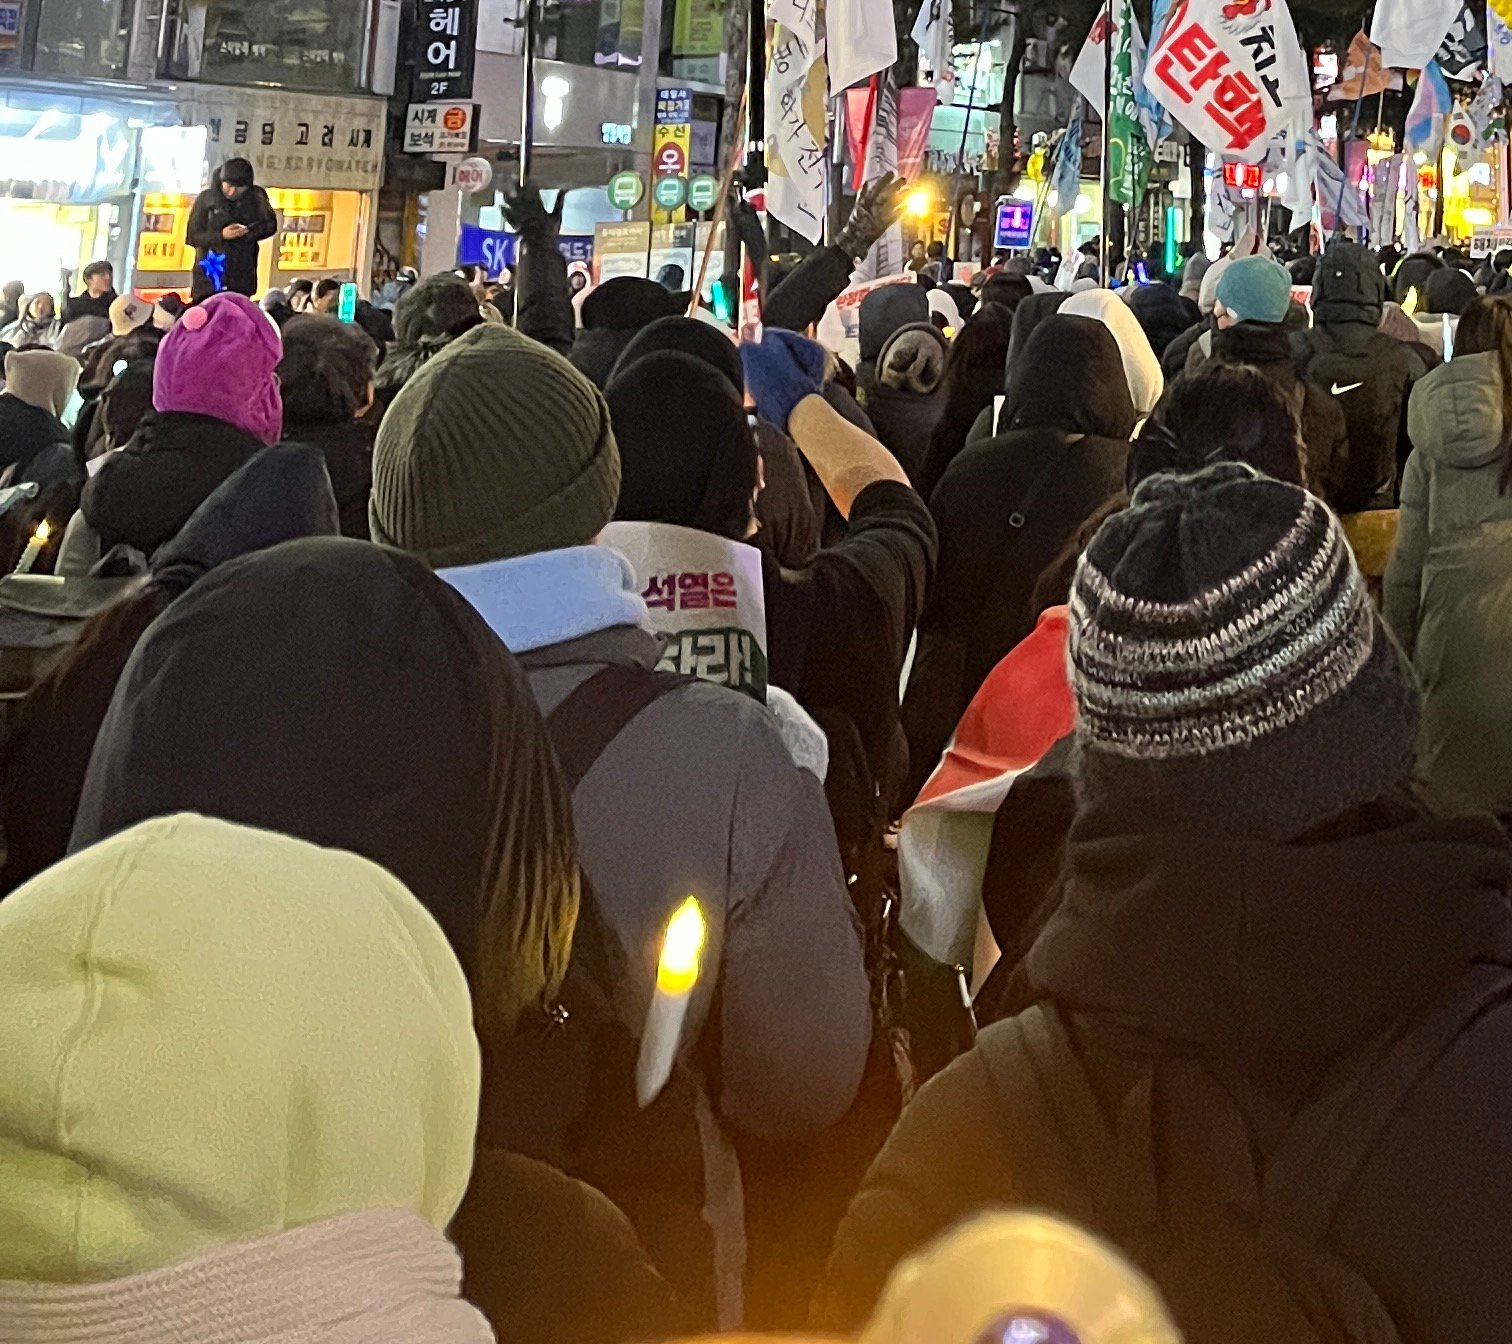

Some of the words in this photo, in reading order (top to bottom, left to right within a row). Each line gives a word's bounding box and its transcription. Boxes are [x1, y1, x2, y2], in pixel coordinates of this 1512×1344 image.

[426, 6, 461, 70] 헤어
[430, 81, 449, 95] 2F
[1154, 22, 1268, 151] 탄핵
[640, 571, 738, 612] 석열은
